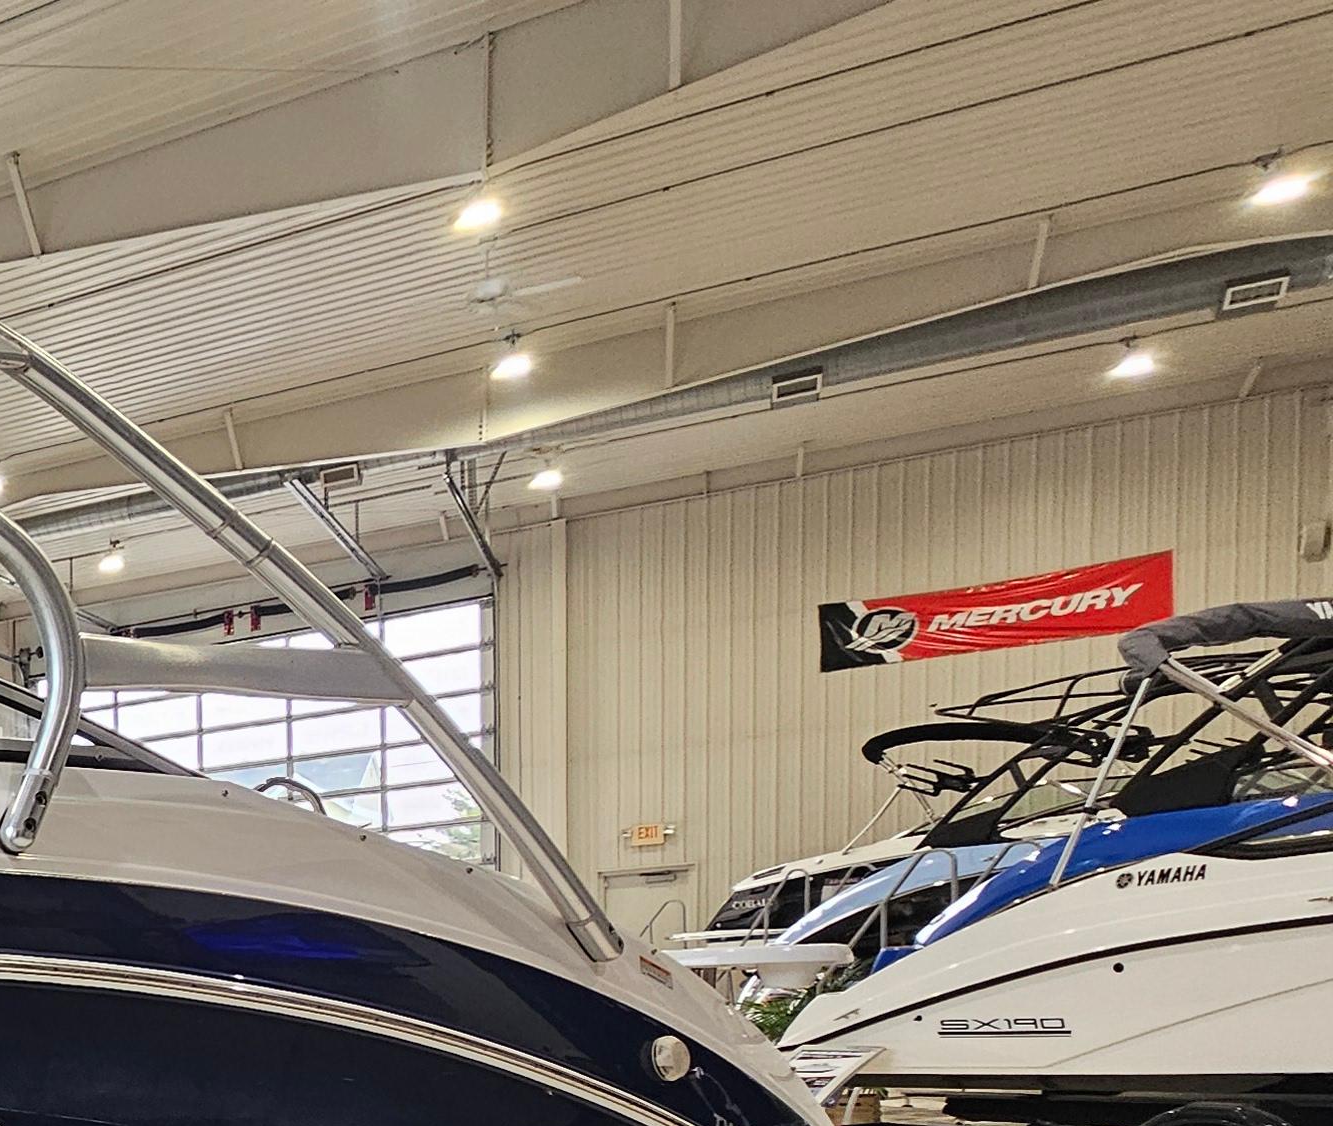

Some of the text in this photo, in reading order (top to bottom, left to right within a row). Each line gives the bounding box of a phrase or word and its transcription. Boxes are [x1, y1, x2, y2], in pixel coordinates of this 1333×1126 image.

[927, 583, 1144, 633] MERCURY
[637, 825, 659, 840] EXIT
[1136, 864, 1207, 887] YAMAHA
[733, 897, 774, 910] COBAL
[940, 1018, 1066, 1031] SX190
